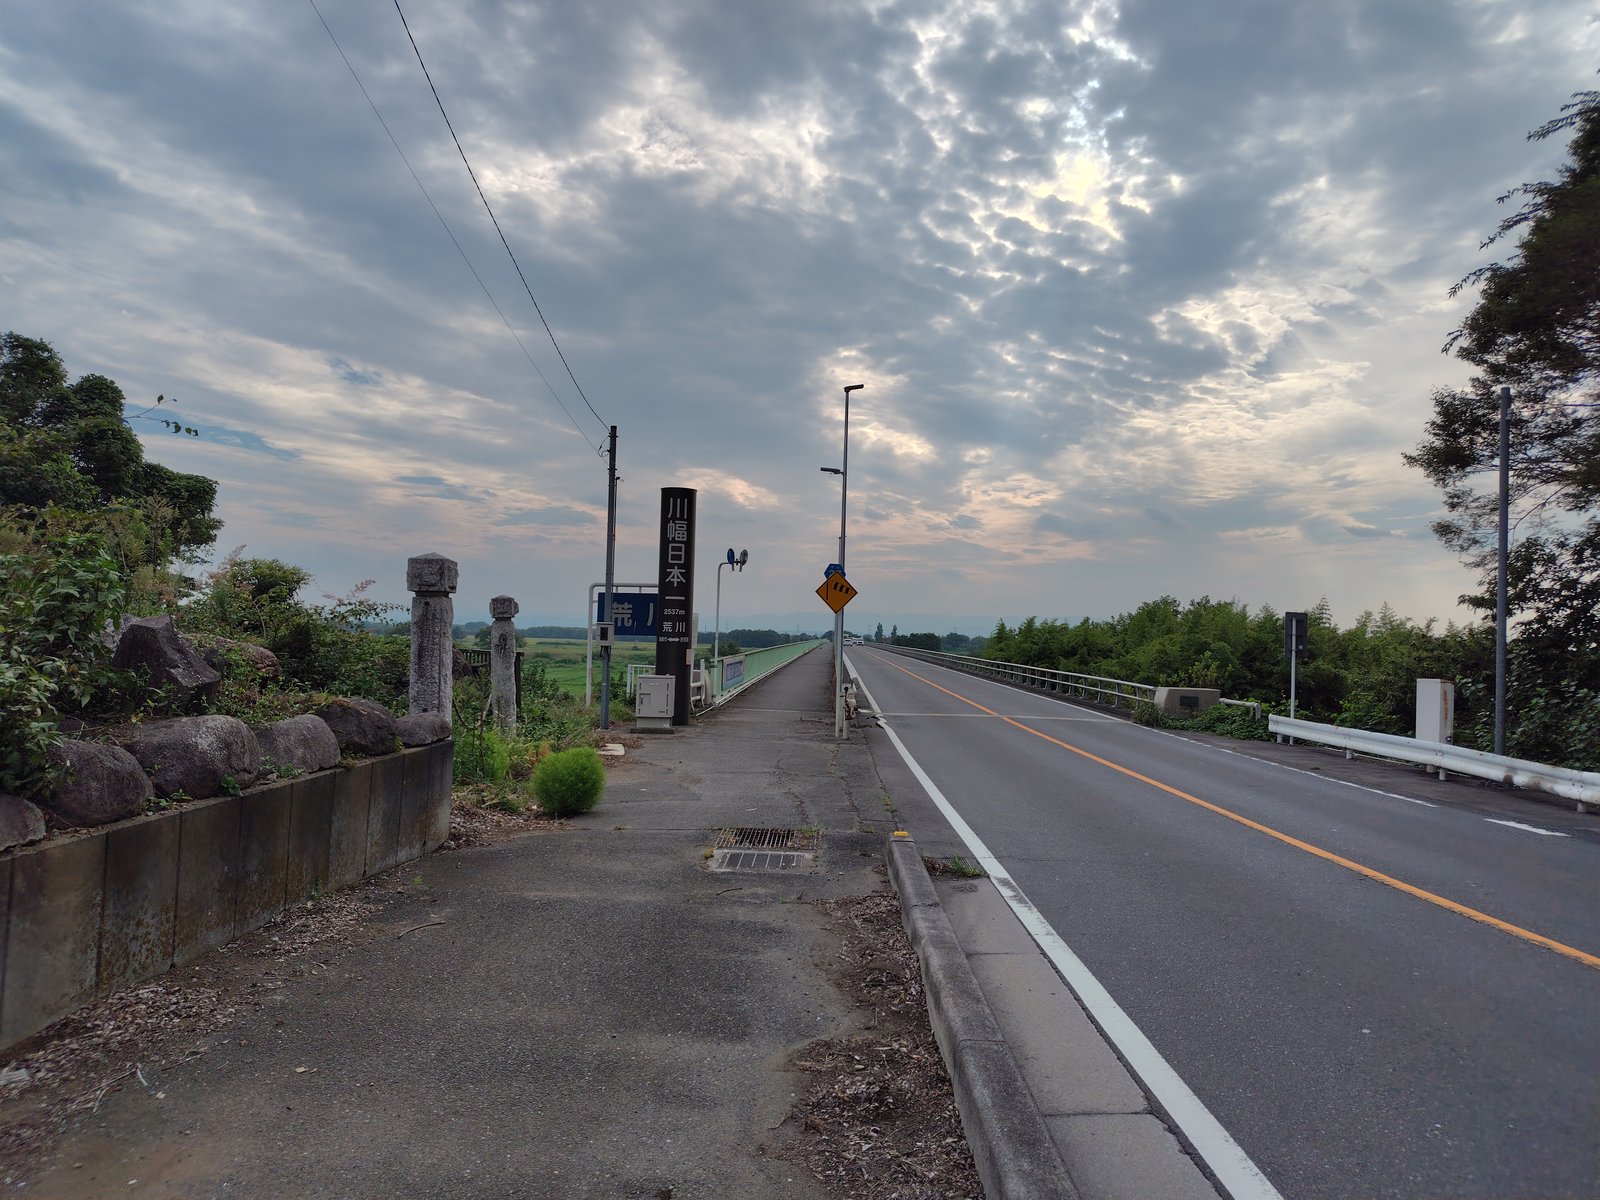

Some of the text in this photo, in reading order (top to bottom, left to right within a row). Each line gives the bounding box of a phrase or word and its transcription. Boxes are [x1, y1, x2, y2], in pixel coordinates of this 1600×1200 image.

[665, 498, 688, 600] 川幅日本一
[662, 621, 686, 633] 荒川
